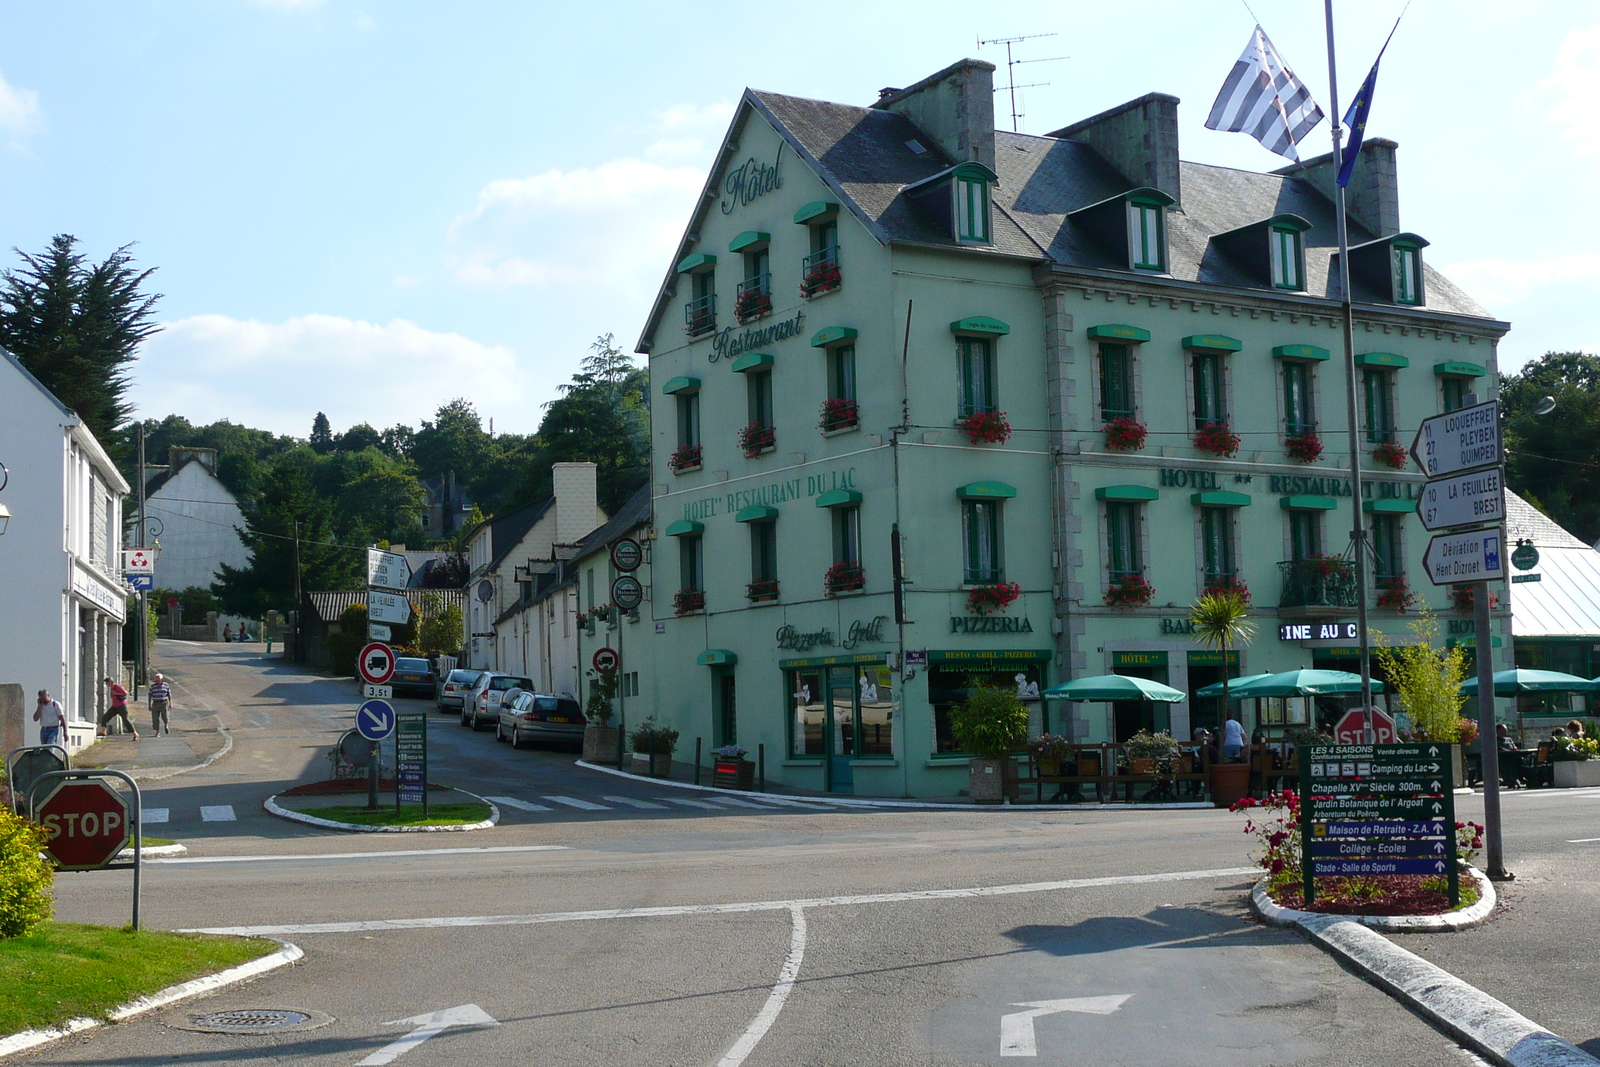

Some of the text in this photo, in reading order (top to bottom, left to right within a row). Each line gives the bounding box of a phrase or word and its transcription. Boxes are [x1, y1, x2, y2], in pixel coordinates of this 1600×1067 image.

[722, 140, 785, 215] Hôtel
[709, 311, 804, 363] Restaurant
[1425, 407, 1495, 438] 11 LOQUEFFRET
[1426, 426, 1495, 455] 27 PLEYBEN
[1427, 445, 1496, 473] 60 QUIMPER
[1161, 469, 1221, 490] HOTEL
[1379, 481, 1401, 499] DU
[1428, 489, 1437, 503] 10
[1448, 485, 1459, 500] LA
[1462, 475, 1498, 497] FEUILLÉE
[727, 479, 801, 513] RESTAURANT
[808, 474, 826, 496] DU
[1427, 498, 1499, 523] 67 BREST
[1442, 540, 1479, 558] Déviation
[1436, 560, 1480, 578] Hent Dizroet
[843, 616, 887, 650] Grill
[950, 616, 1034, 634] PIZZERIA
[1162, 618, 1196, 635] BAR
[1281, 624, 1356, 640] INE AU C
[1004, 651, 1037, 659] PIZZERIA
[1311, 747, 1327, 755] LES
[1329, 746, 1335, 754] 4
[1336, 746, 1374, 754] SAISONS
[1372, 763, 1428, 775] Camping du Lac
[1312, 783, 1348, 794] Chapelle
[1370, 782, 1395, 792] Siècle
[1314, 799, 1338, 809] Jardin
[1340, 799, 1378, 809] Botanique
[1380, 799, 1389, 807] de
[44, 812, 121, 839] STOP
[1328, 826, 1359, 835] Maison
[1361, 825, 1371, 834] de
[1373, 825, 1406, 834] Retraite
[1412, 824, 1430, 834] Z.A.
[1340, 844, 1371, 856] Collège
[1378, 843, 1407, 853] Ecoles
[1315, 863, 1336, 873] Stade
[1341, 863, 1360, 872] Salle
[1361, 863, 1370, 872] de
[1371, 862, 1396, 874] Sports
